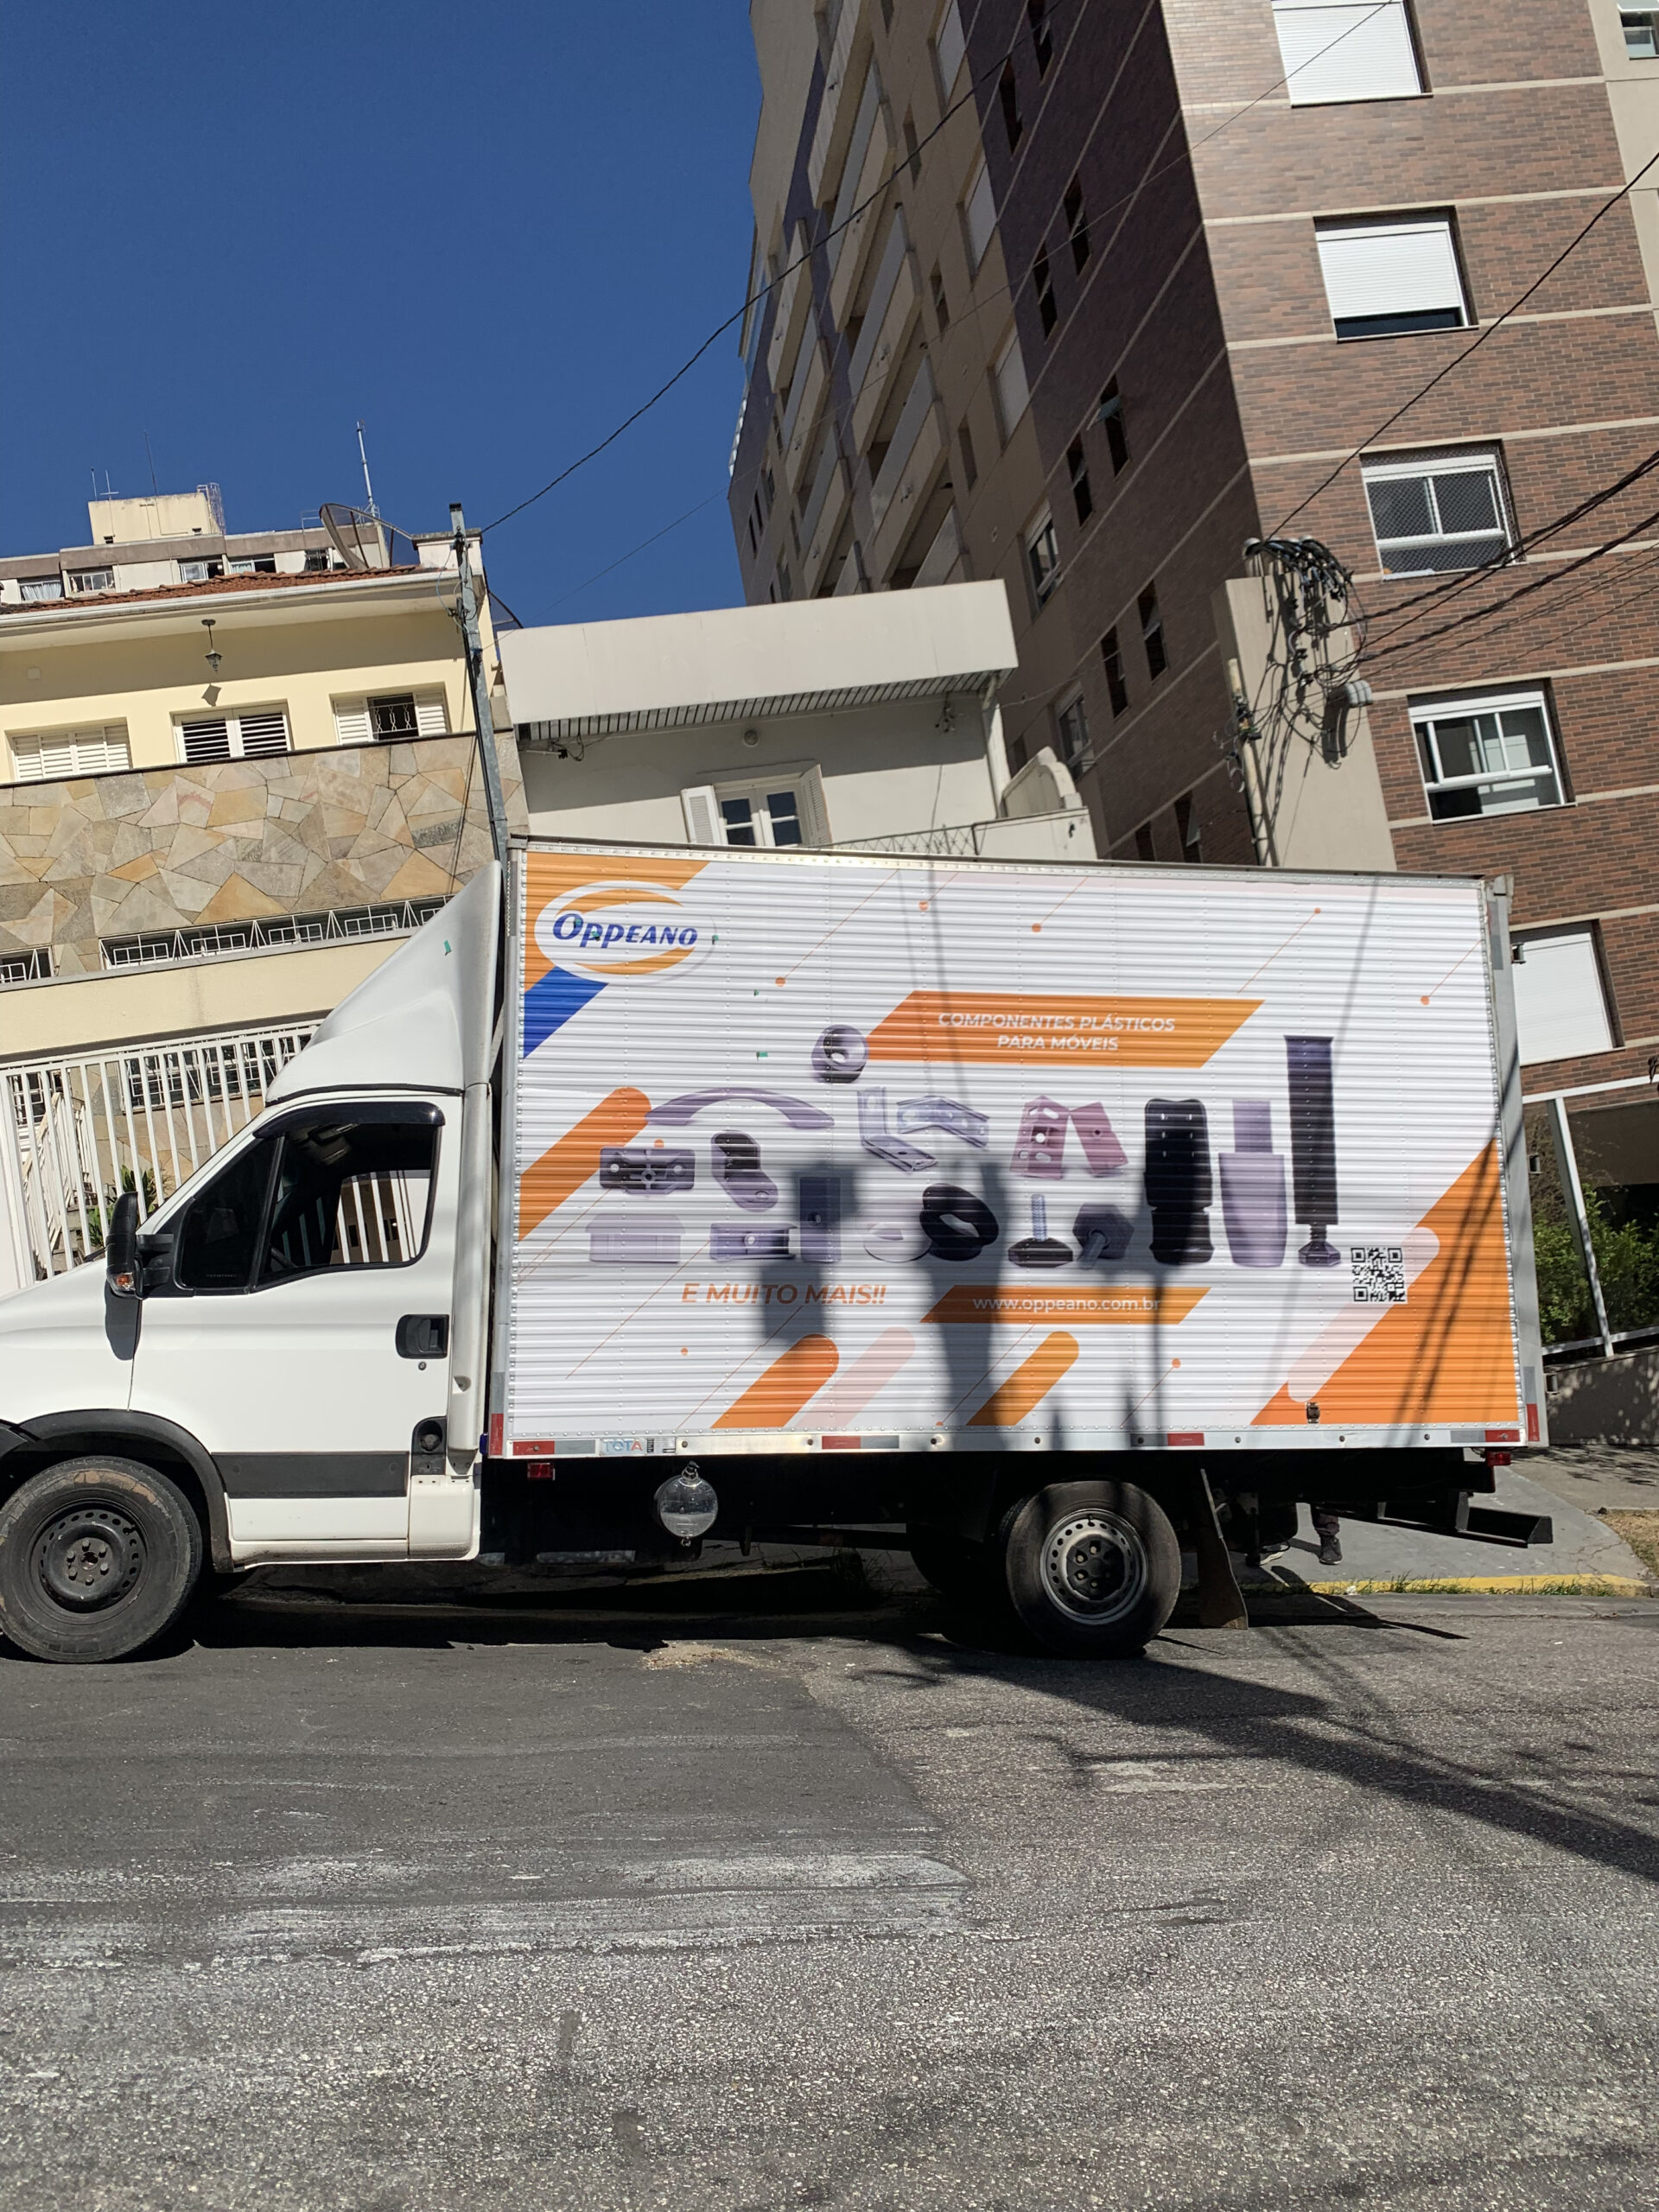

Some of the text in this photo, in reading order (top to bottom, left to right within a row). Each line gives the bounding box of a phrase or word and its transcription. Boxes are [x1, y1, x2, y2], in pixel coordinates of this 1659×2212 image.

[938, 1012, 1176, 1032] COMPONENTES PLÁSTICOS
[997, 1033, 1119, 1051] PARA MÓVEIS
[682, 1282, 887, 1305] E MUITO MAIS!!
[973, 1296, 1161, 1313] www.oppeano.com.br
